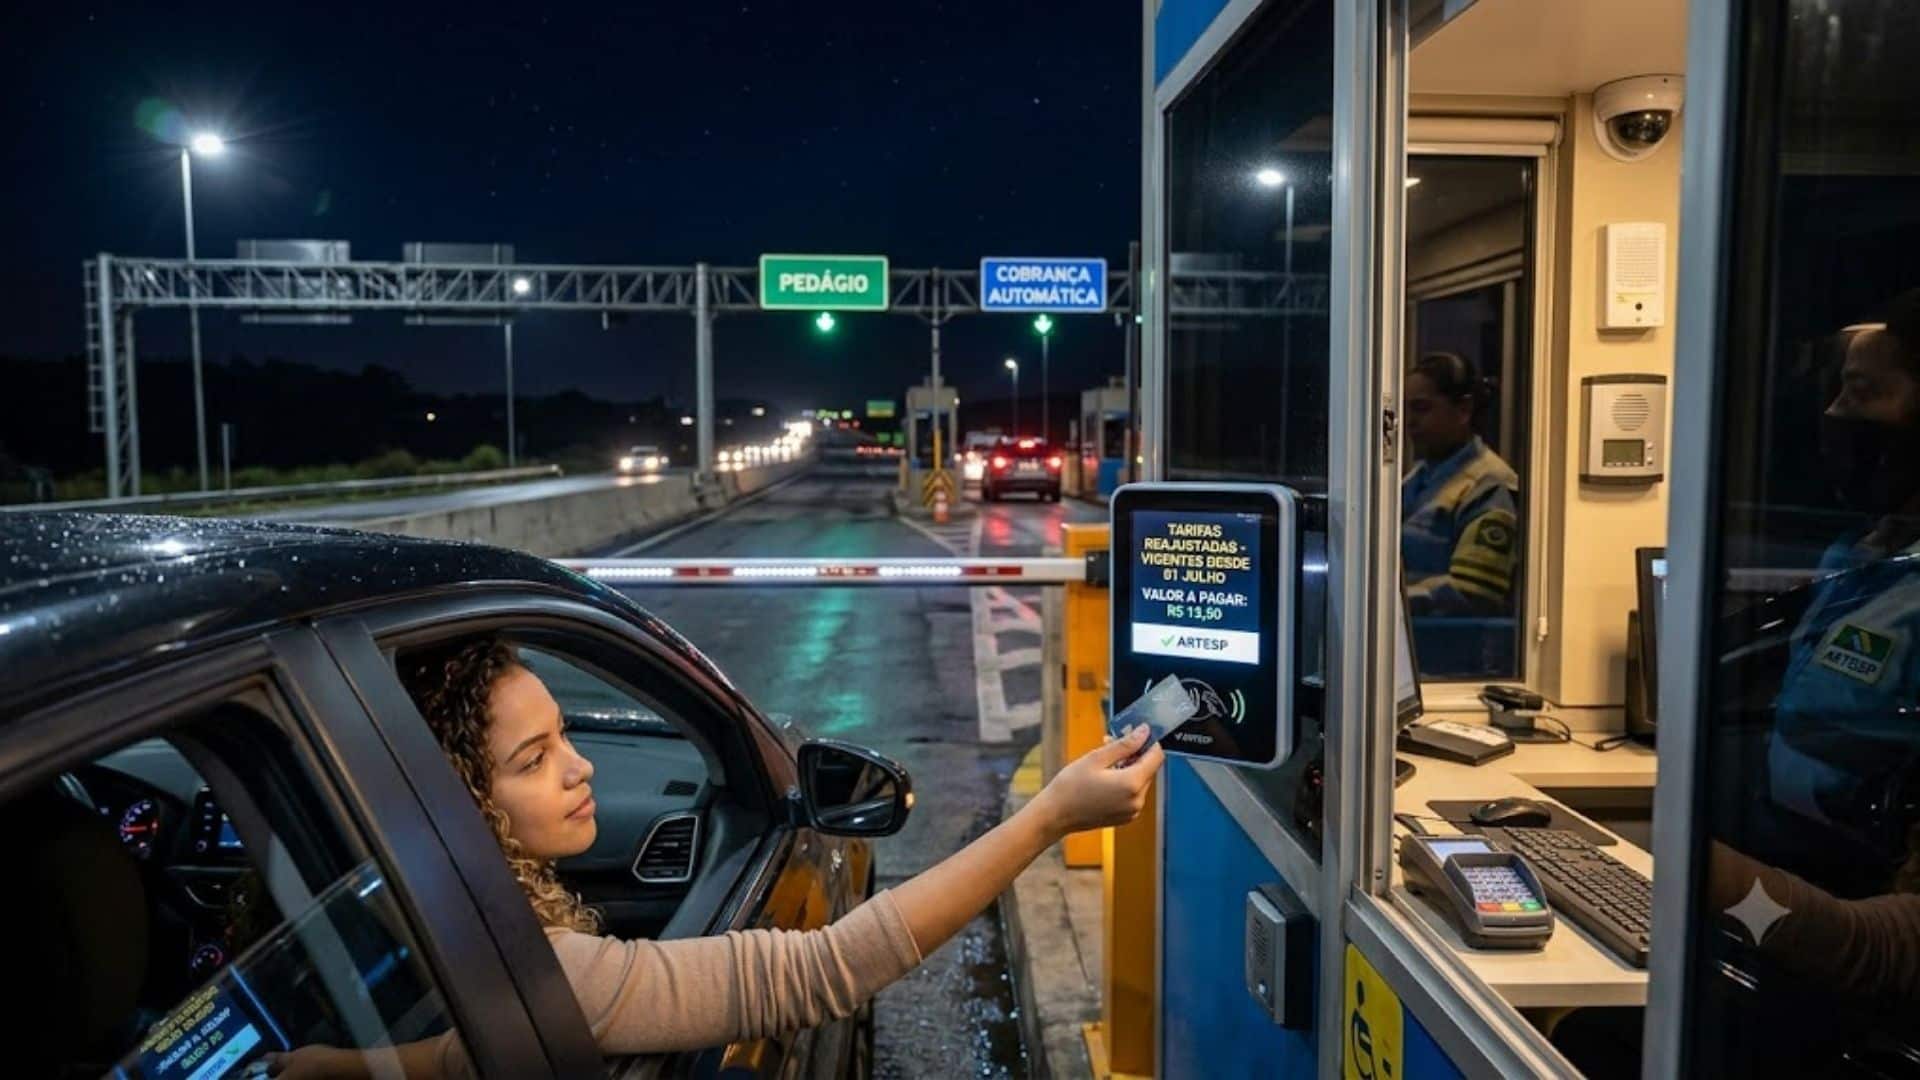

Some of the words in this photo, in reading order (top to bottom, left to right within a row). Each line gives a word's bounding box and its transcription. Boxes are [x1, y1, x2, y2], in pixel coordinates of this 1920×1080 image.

[779, 270, 869, 293] PEDÁGIO
[996, 265, 1091, 286] COBRANÇA
[988, 284, 1098, 304] AUTOMÁTICA
[1167, 523, 1222, 537] TARIFAS
[1144, 537, 1238, 553] REAJUSTADAS
[1141, 552, 1204, 567] VIGENTES
[1163, 568, 1178, 581] 01
[1182, 570, 1226, 584] JULHO
[1142, 587, 1184, 601] VALOR
[1186, 590, 1196, 603] A
[1199, 591, 1248, 606] PAGAR:
[1187, 605, 1222, 621] 13,50
[1177, 636, 1229, 651] ARTESP
